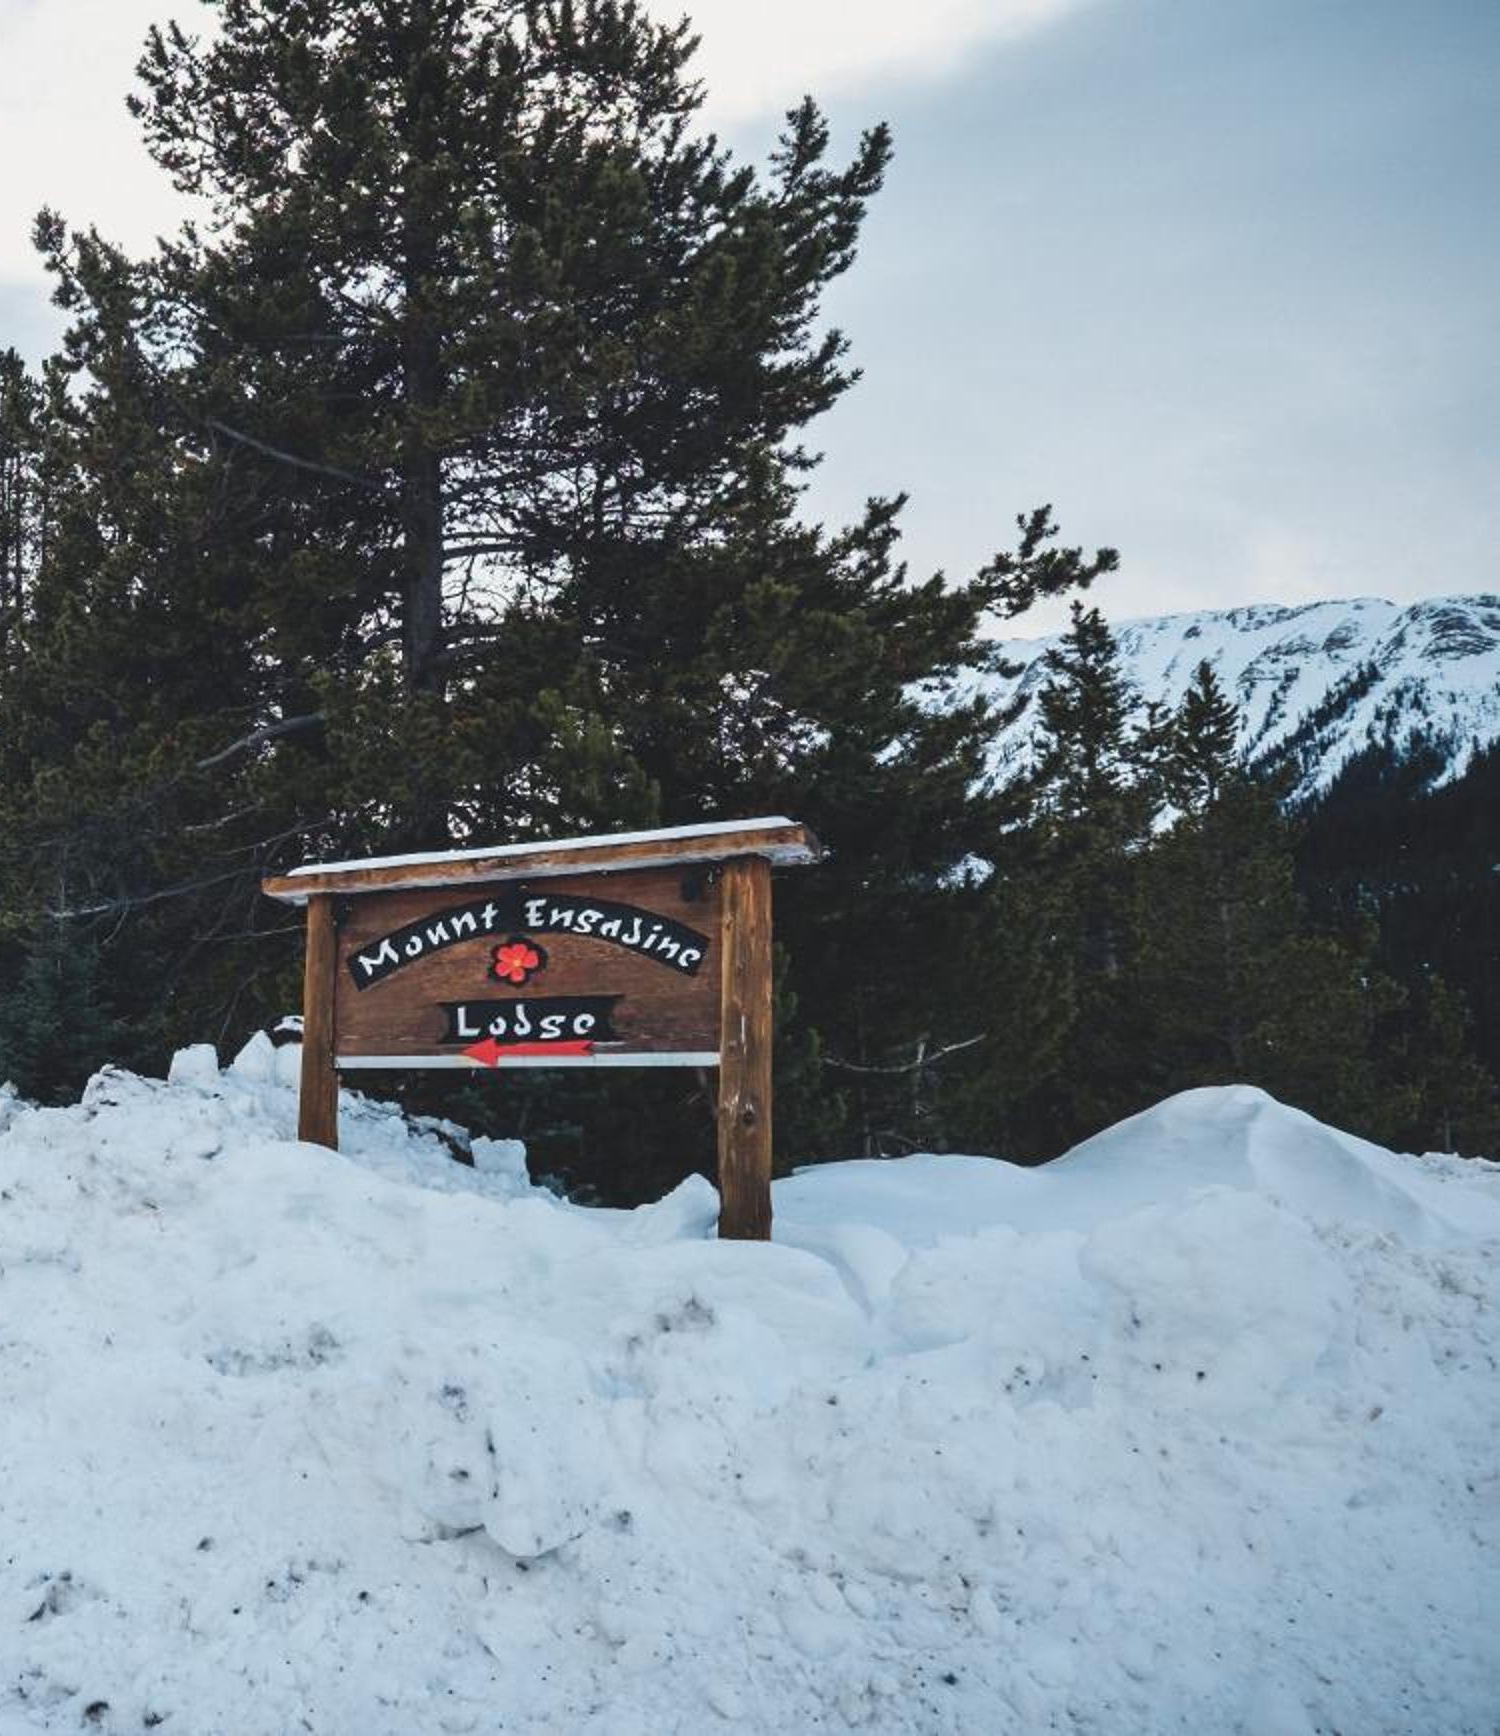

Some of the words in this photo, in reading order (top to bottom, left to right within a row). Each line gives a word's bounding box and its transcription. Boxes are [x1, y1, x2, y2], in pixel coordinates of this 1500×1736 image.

[358, 902, 499, 977] Mount
[524, 898, 702, 968] Engadine
[457, 1004, 596, 1038] Lodge
